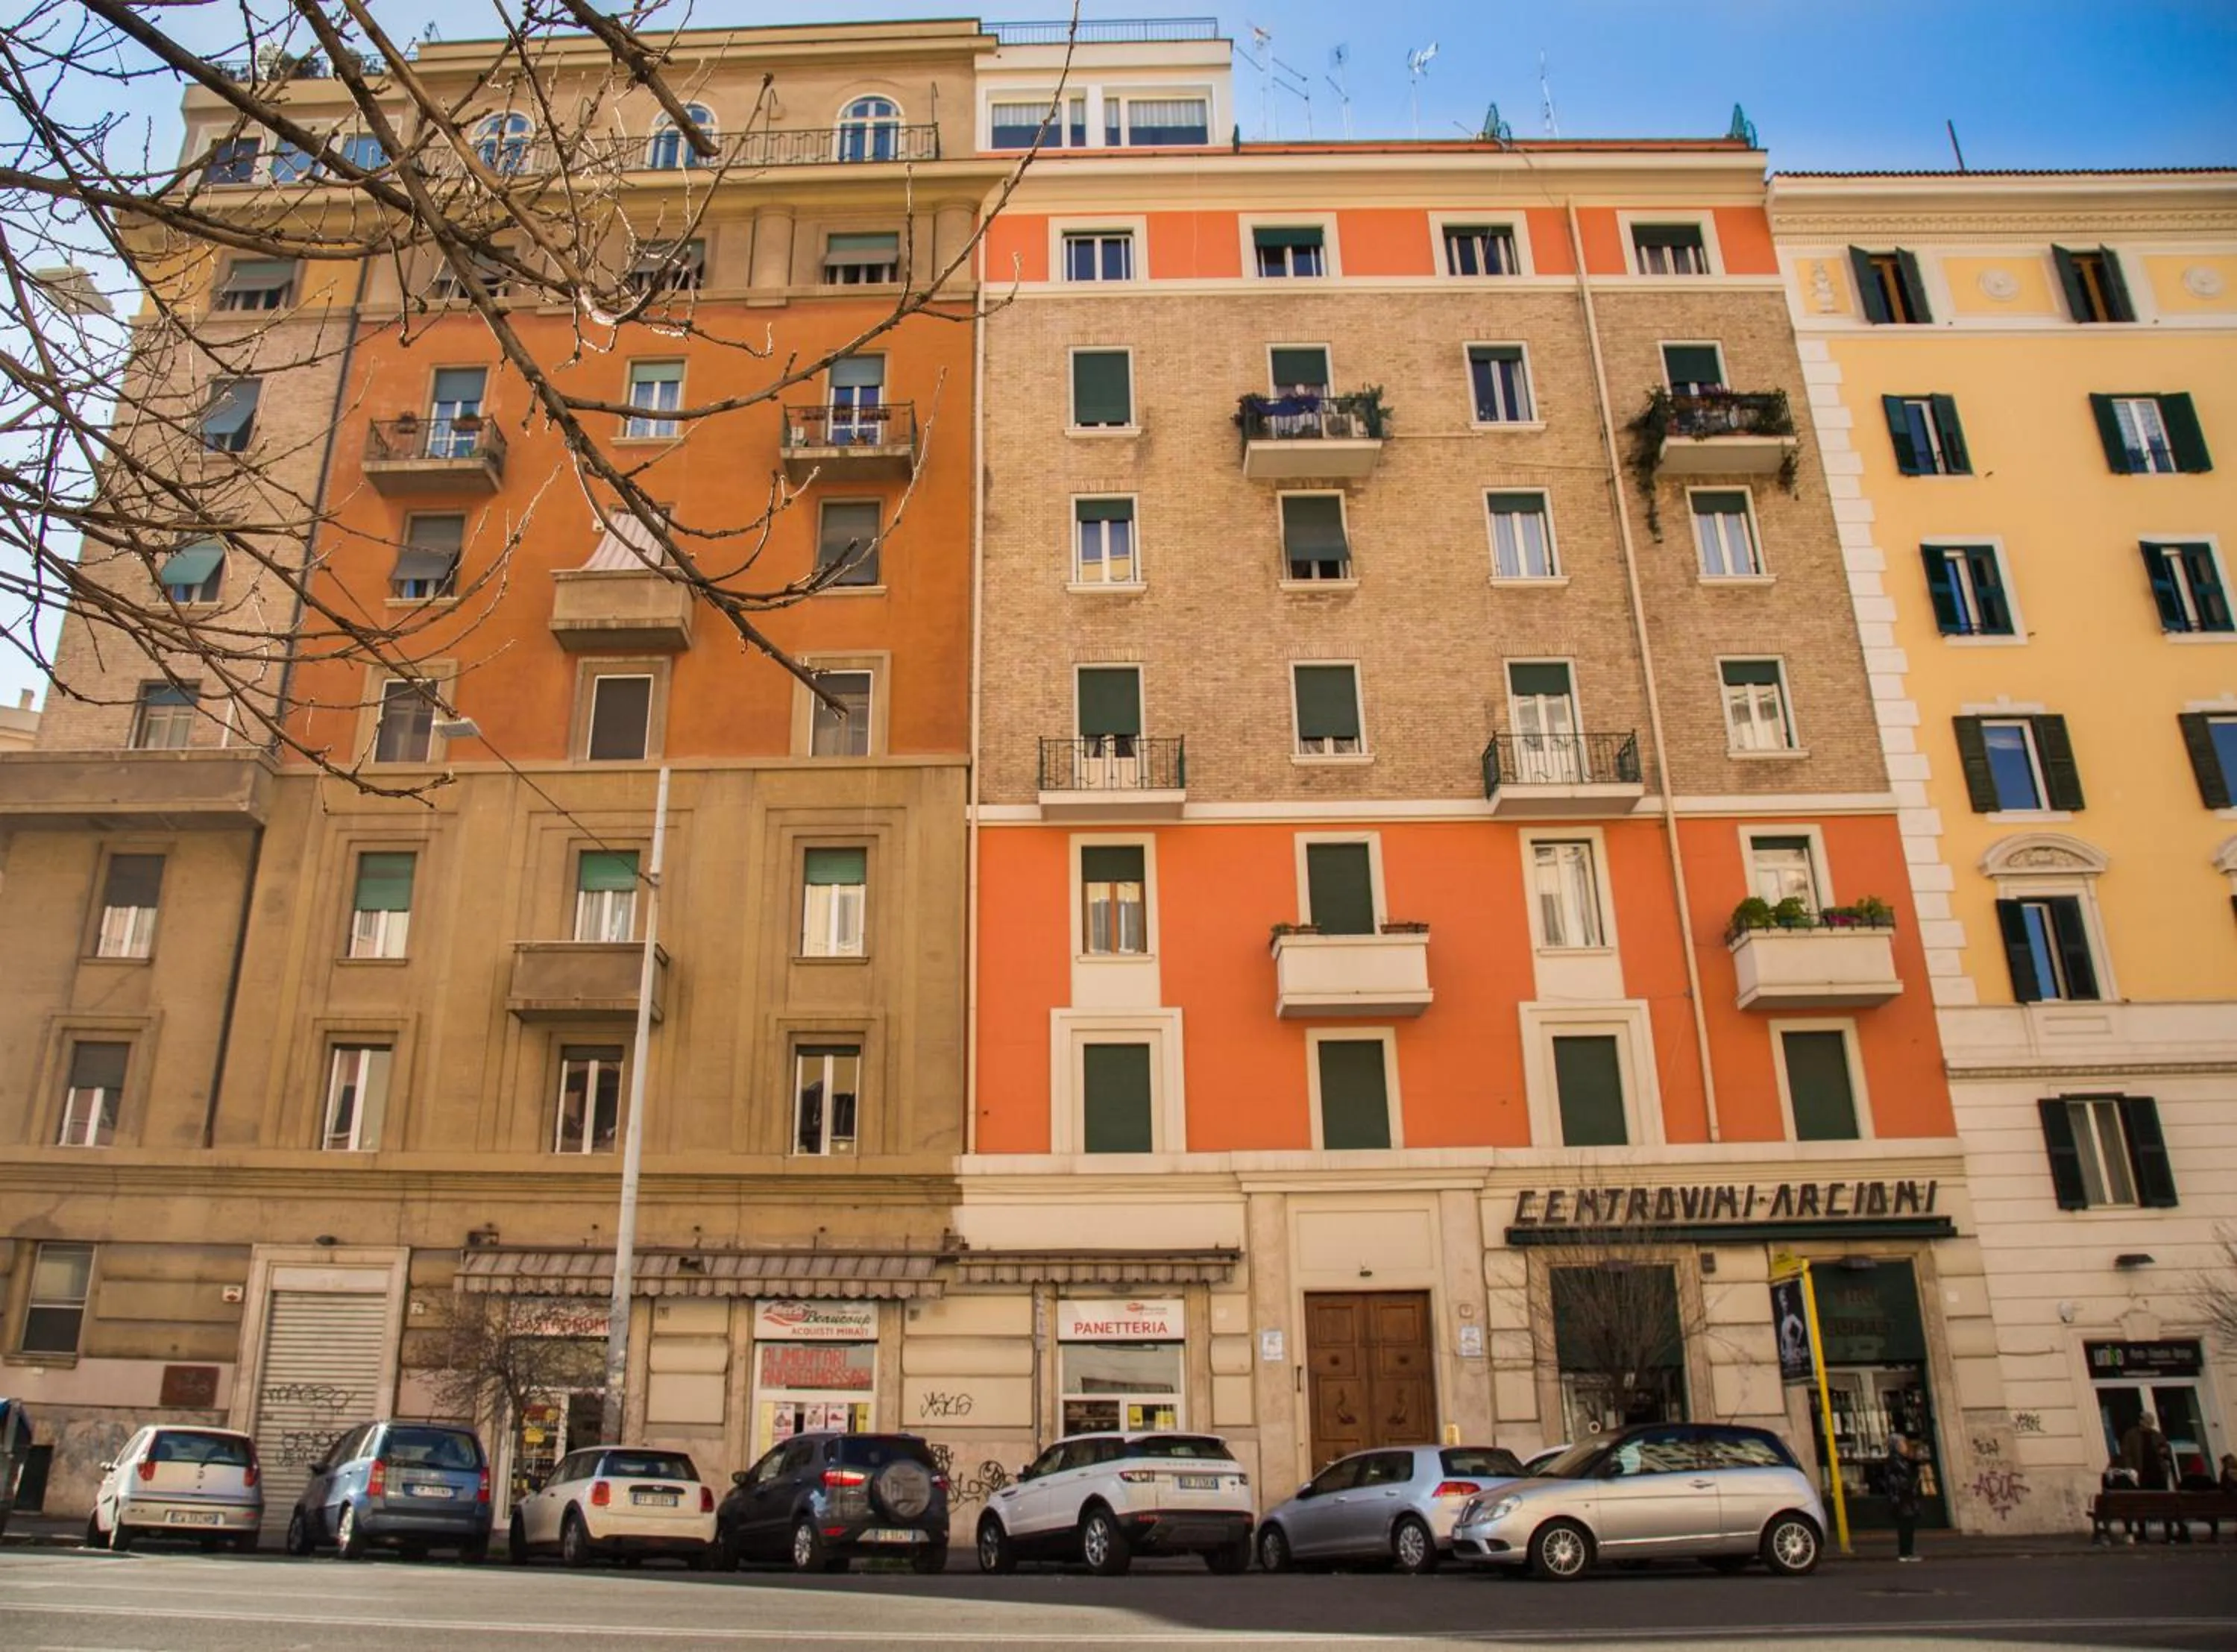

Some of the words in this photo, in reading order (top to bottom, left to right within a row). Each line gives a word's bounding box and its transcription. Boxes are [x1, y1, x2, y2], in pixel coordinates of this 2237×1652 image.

[791, 1326, 834, 1336] ACQUISTI
[836, 1326, 869, 1336] MIRATI
[1074, 1322, 1168, 1334] PANETTERIA
